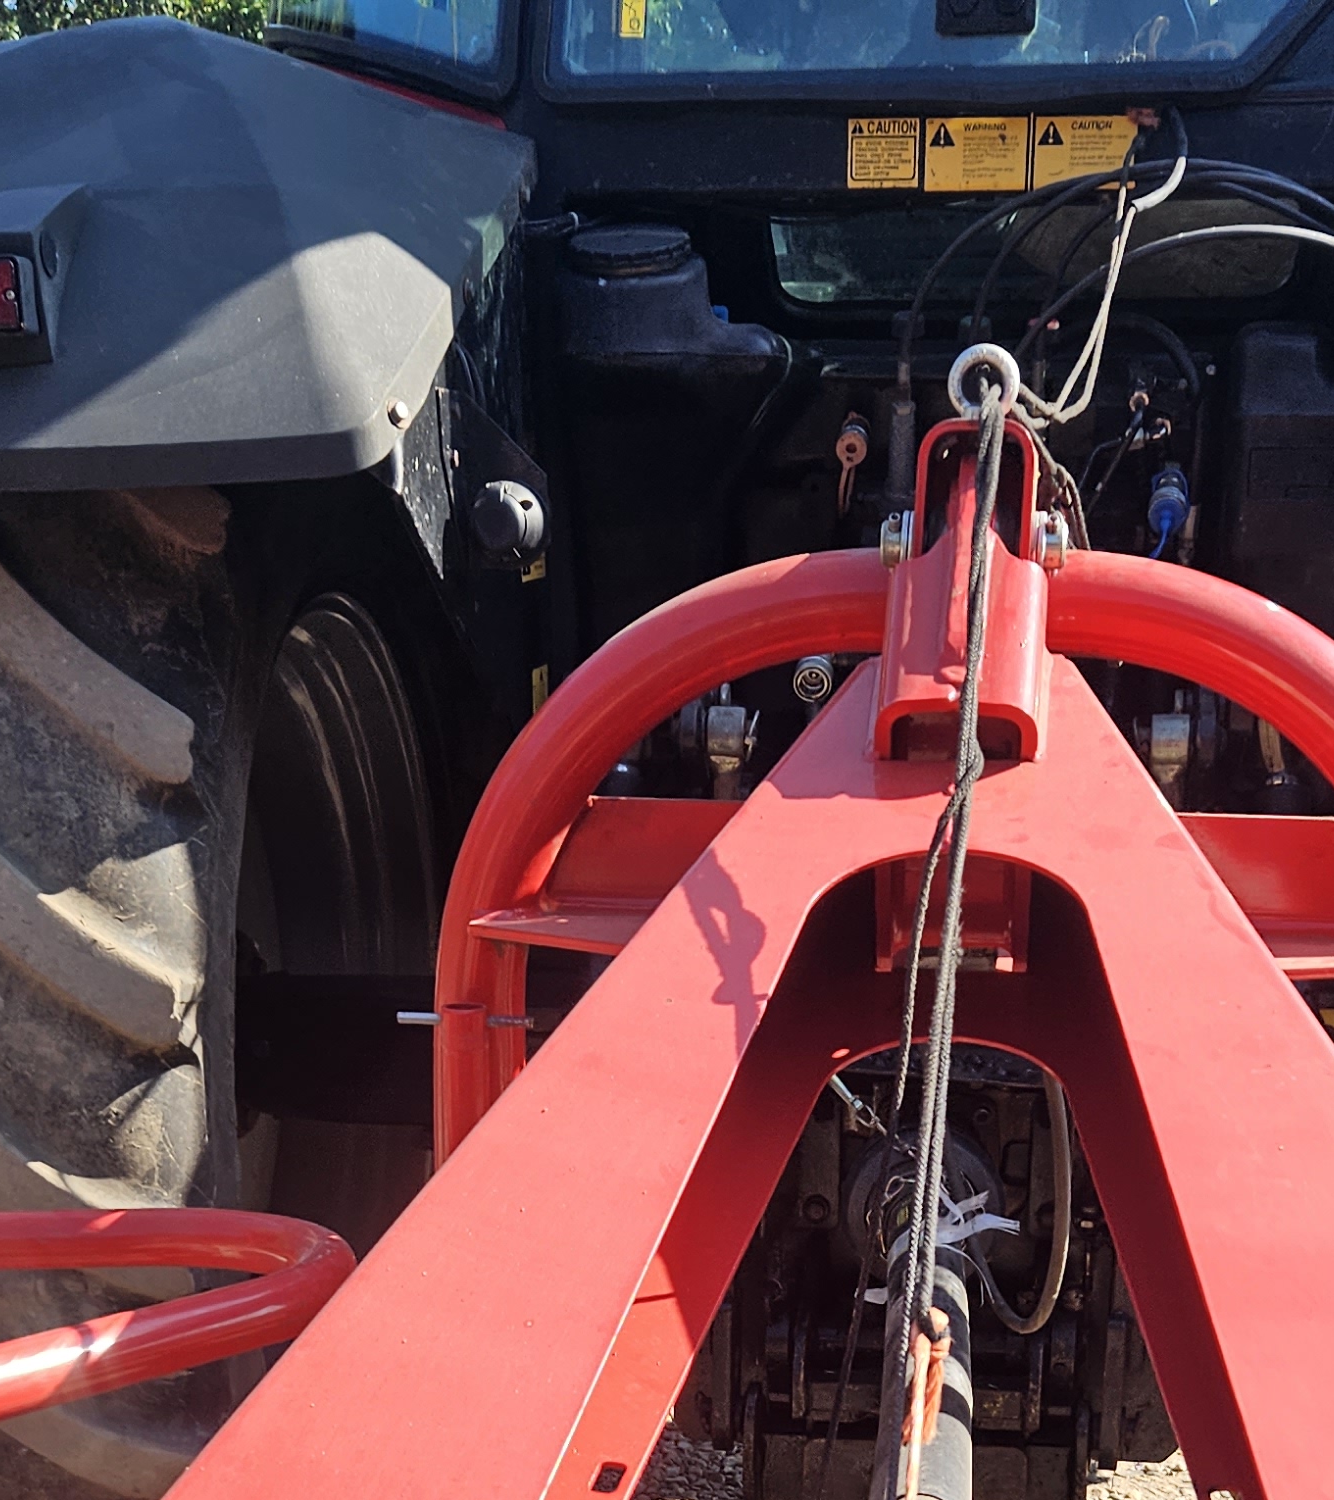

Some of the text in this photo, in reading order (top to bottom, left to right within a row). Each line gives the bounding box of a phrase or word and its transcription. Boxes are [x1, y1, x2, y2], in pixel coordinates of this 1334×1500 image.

[867, 119, 917, 134] CAUTION
[963, 122, 1007, 132] WARNING
[1070, 119, 1113, 131] CAUTION
